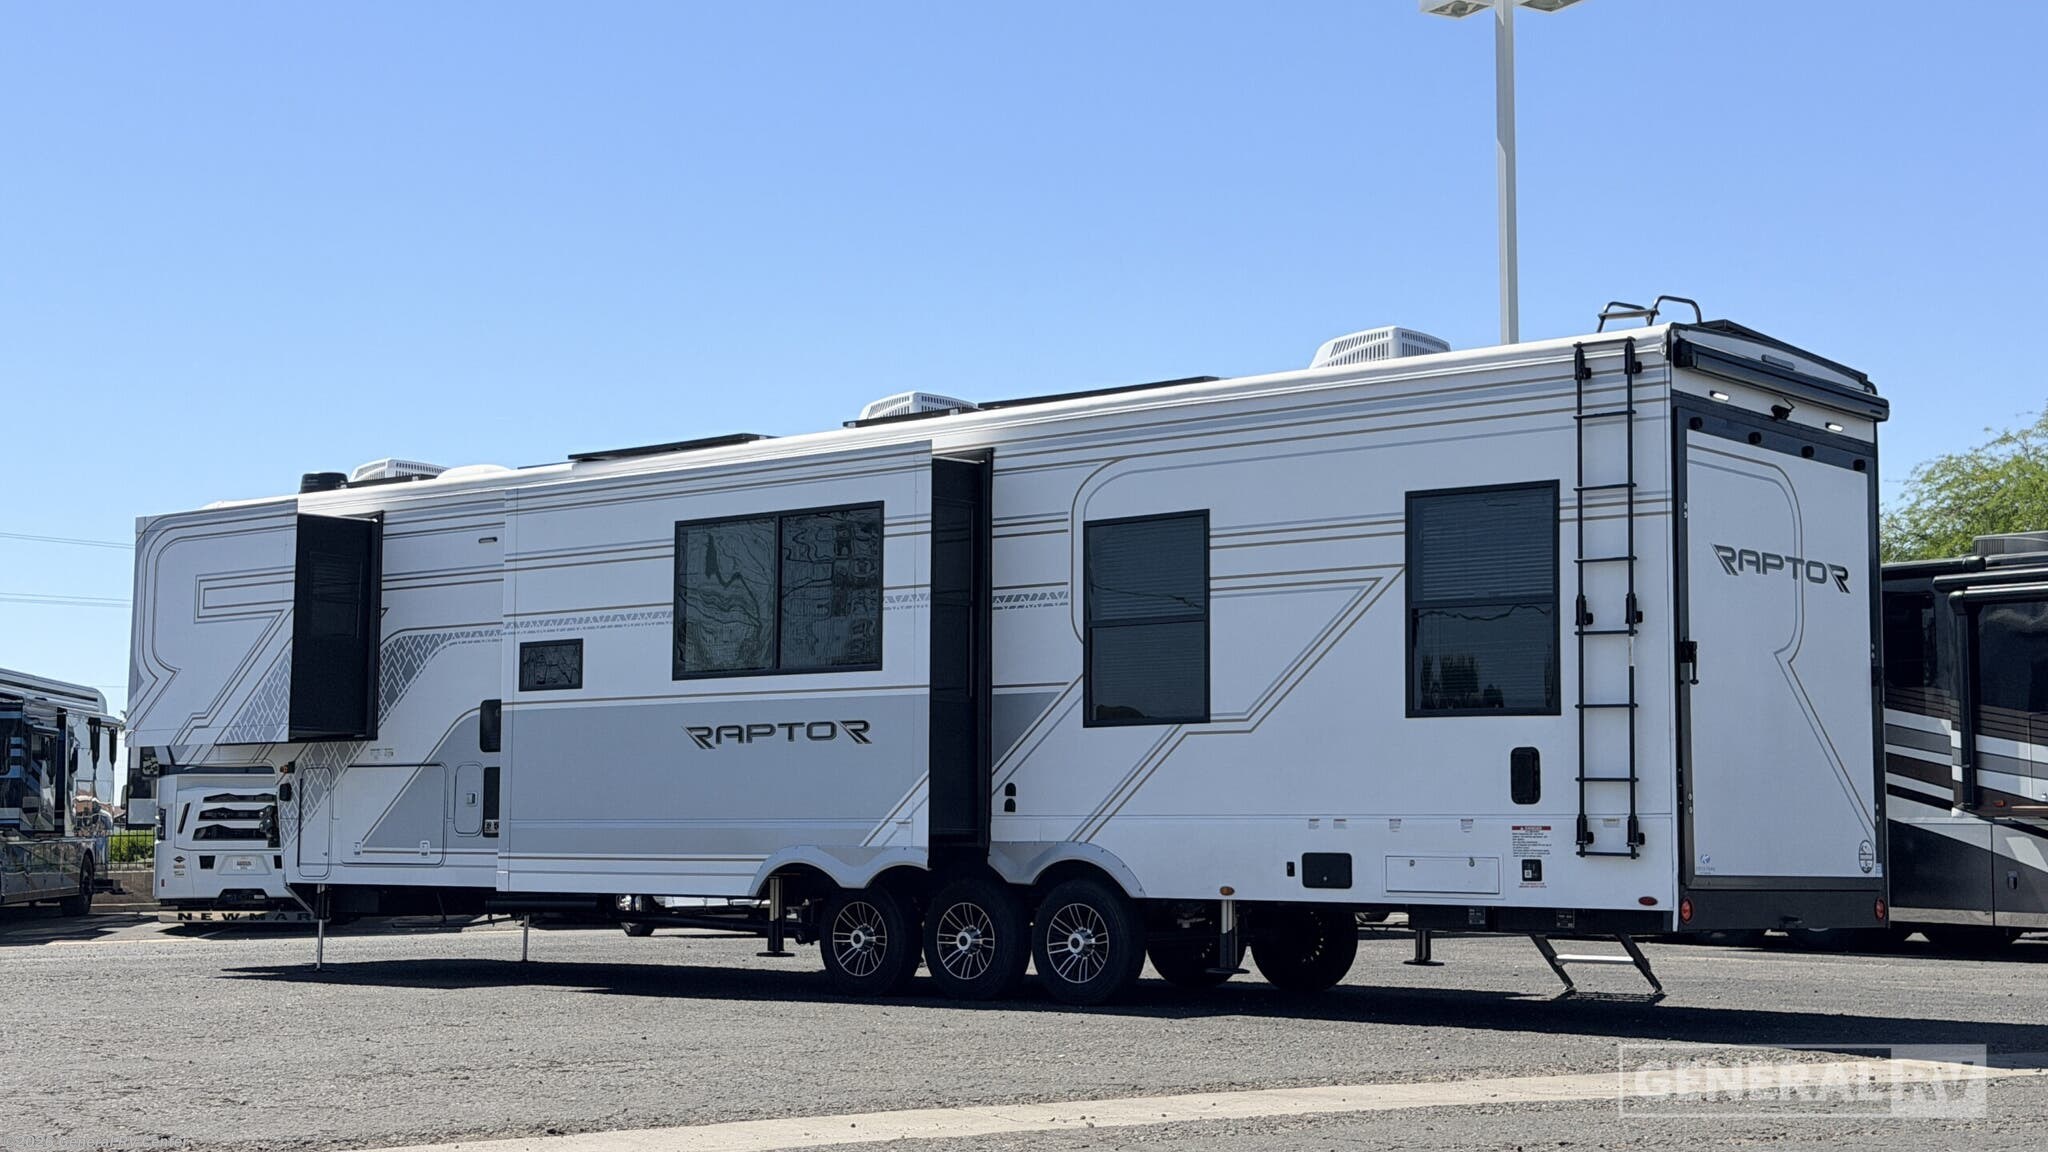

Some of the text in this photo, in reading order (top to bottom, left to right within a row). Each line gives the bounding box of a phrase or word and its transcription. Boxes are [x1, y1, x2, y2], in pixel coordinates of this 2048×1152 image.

[1710, 543, 1850, 594] RAPTOR
[681, 720, 872, 750] RAPTOR
[177, 912, 312, 921] NEWMAR
